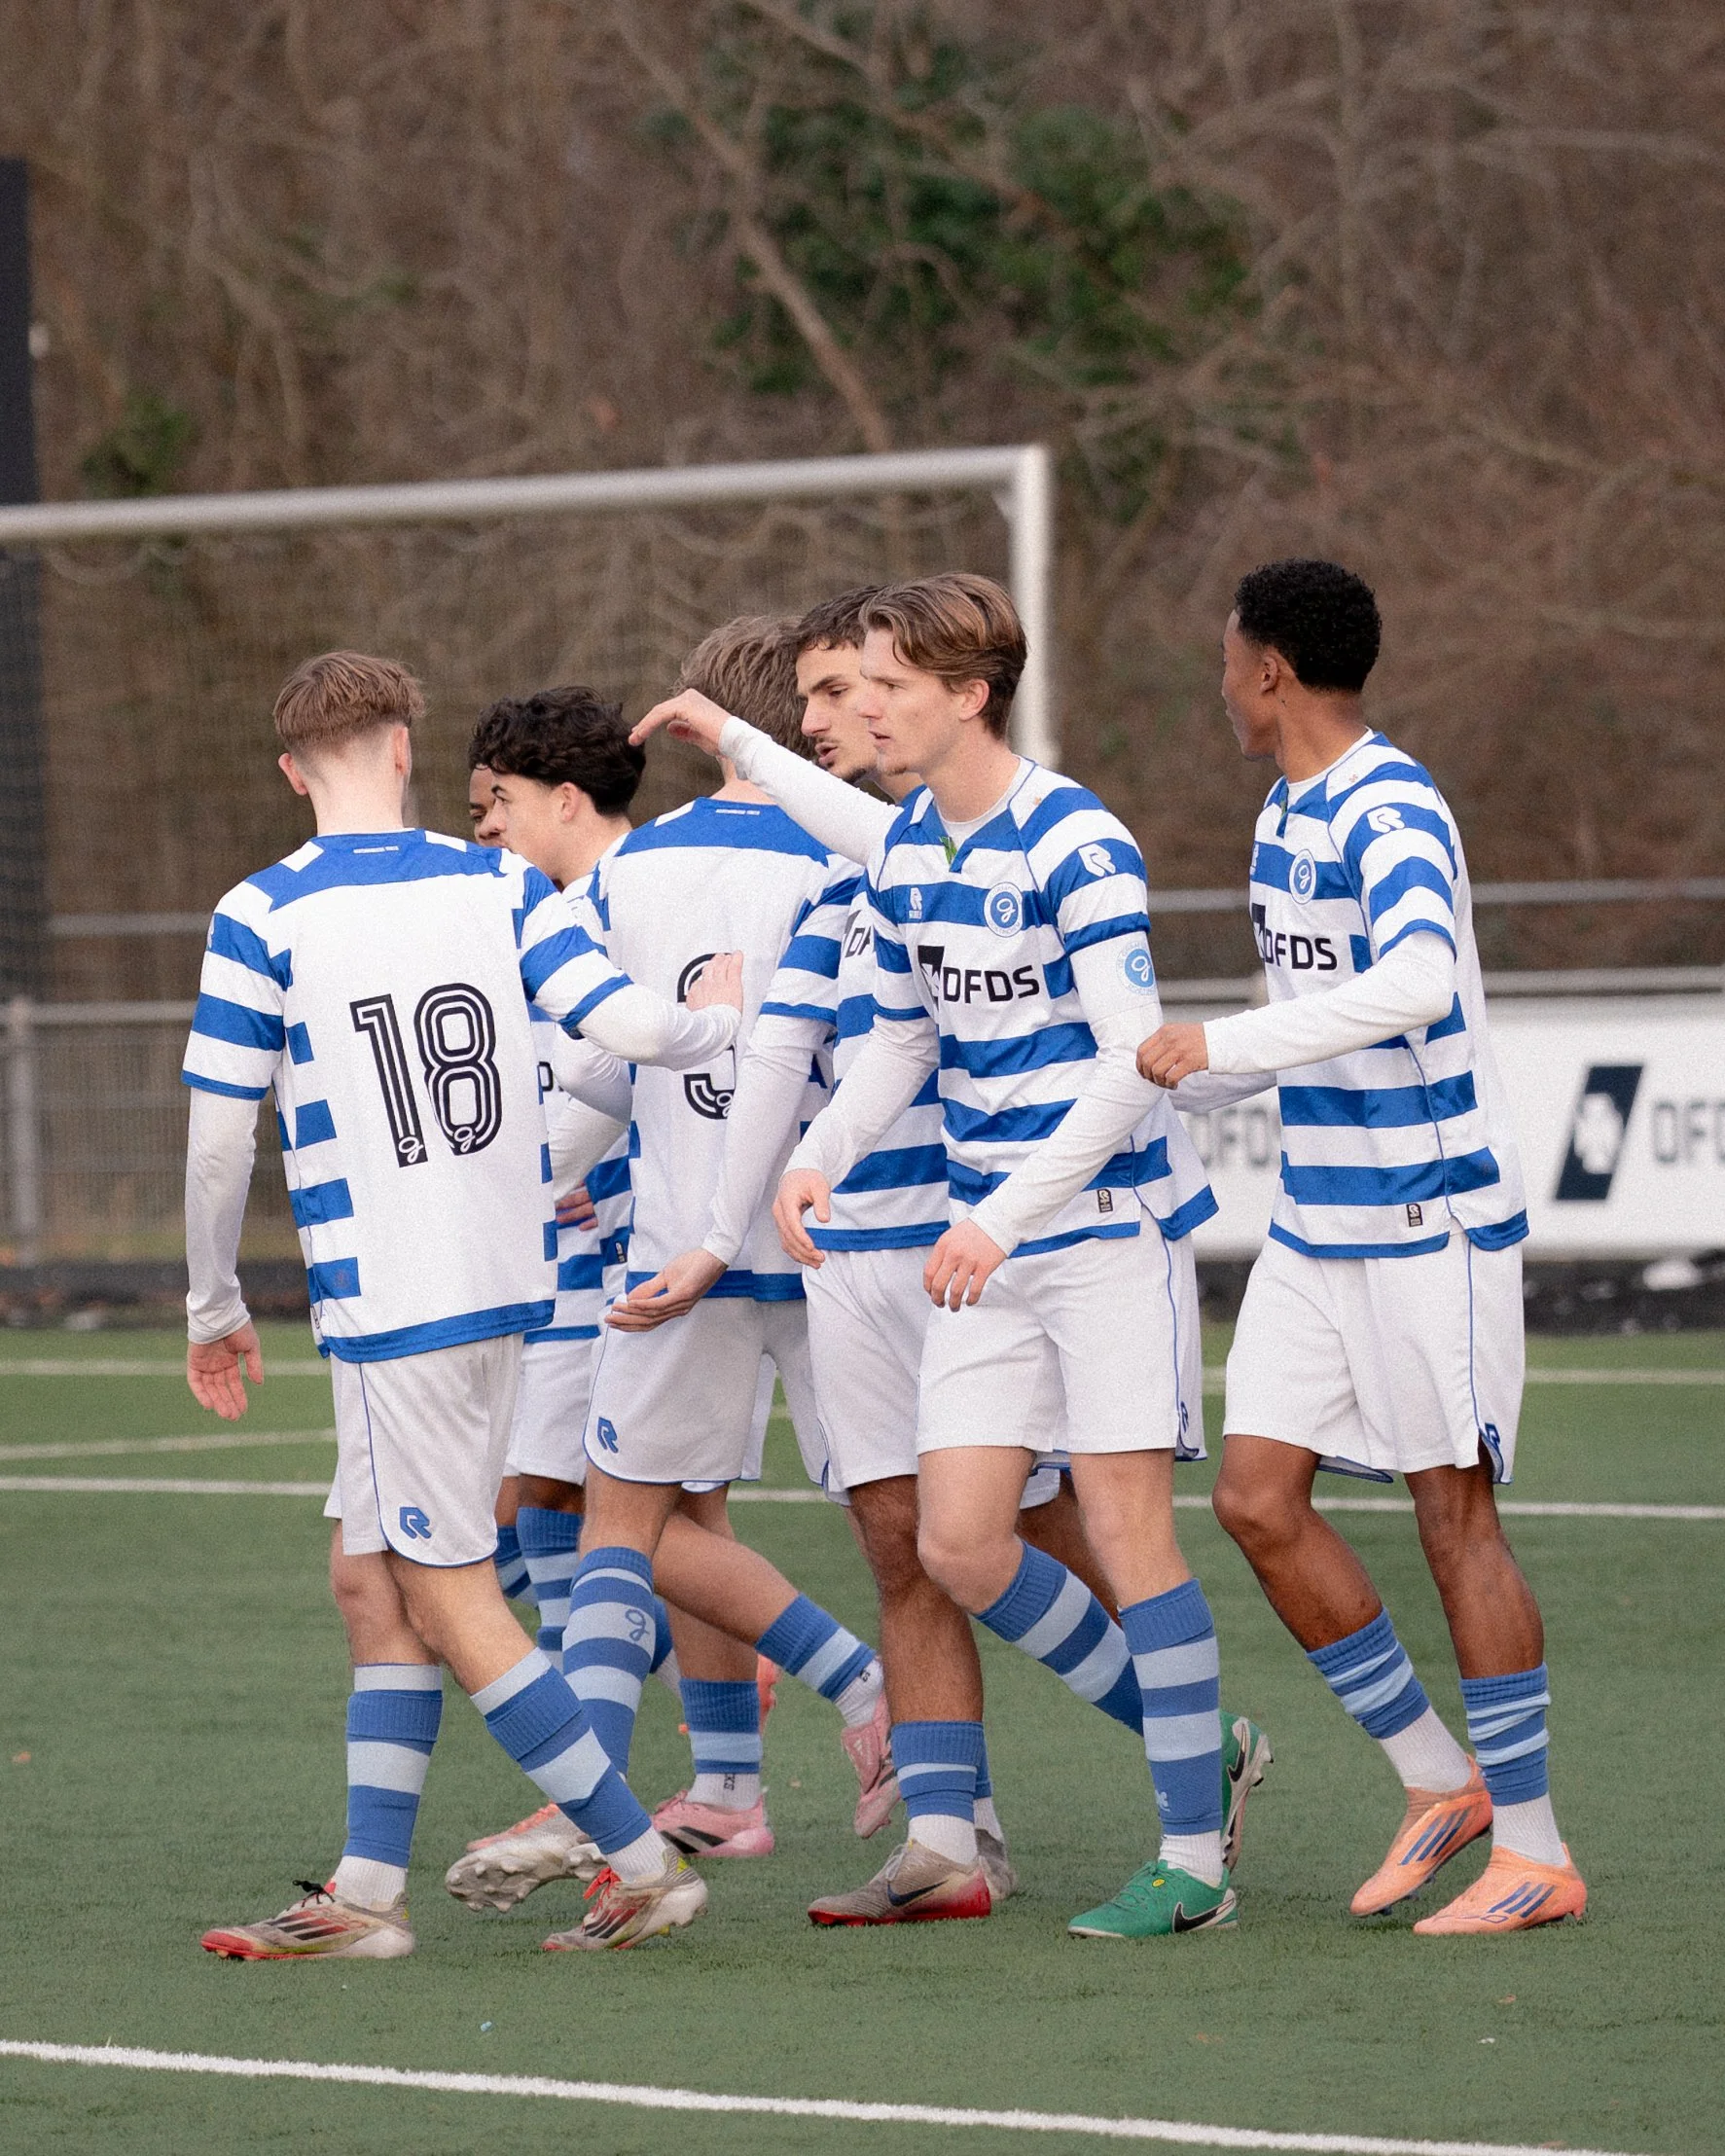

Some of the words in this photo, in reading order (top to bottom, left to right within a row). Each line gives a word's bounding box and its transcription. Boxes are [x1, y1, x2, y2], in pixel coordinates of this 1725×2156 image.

[1265, 928, 1338, 971] DFDS
[943, 965, 1040, 1004] DFDS
[349, 983, 503, 1168] 18
[1187, 1105, 1281, 1168] DFD
